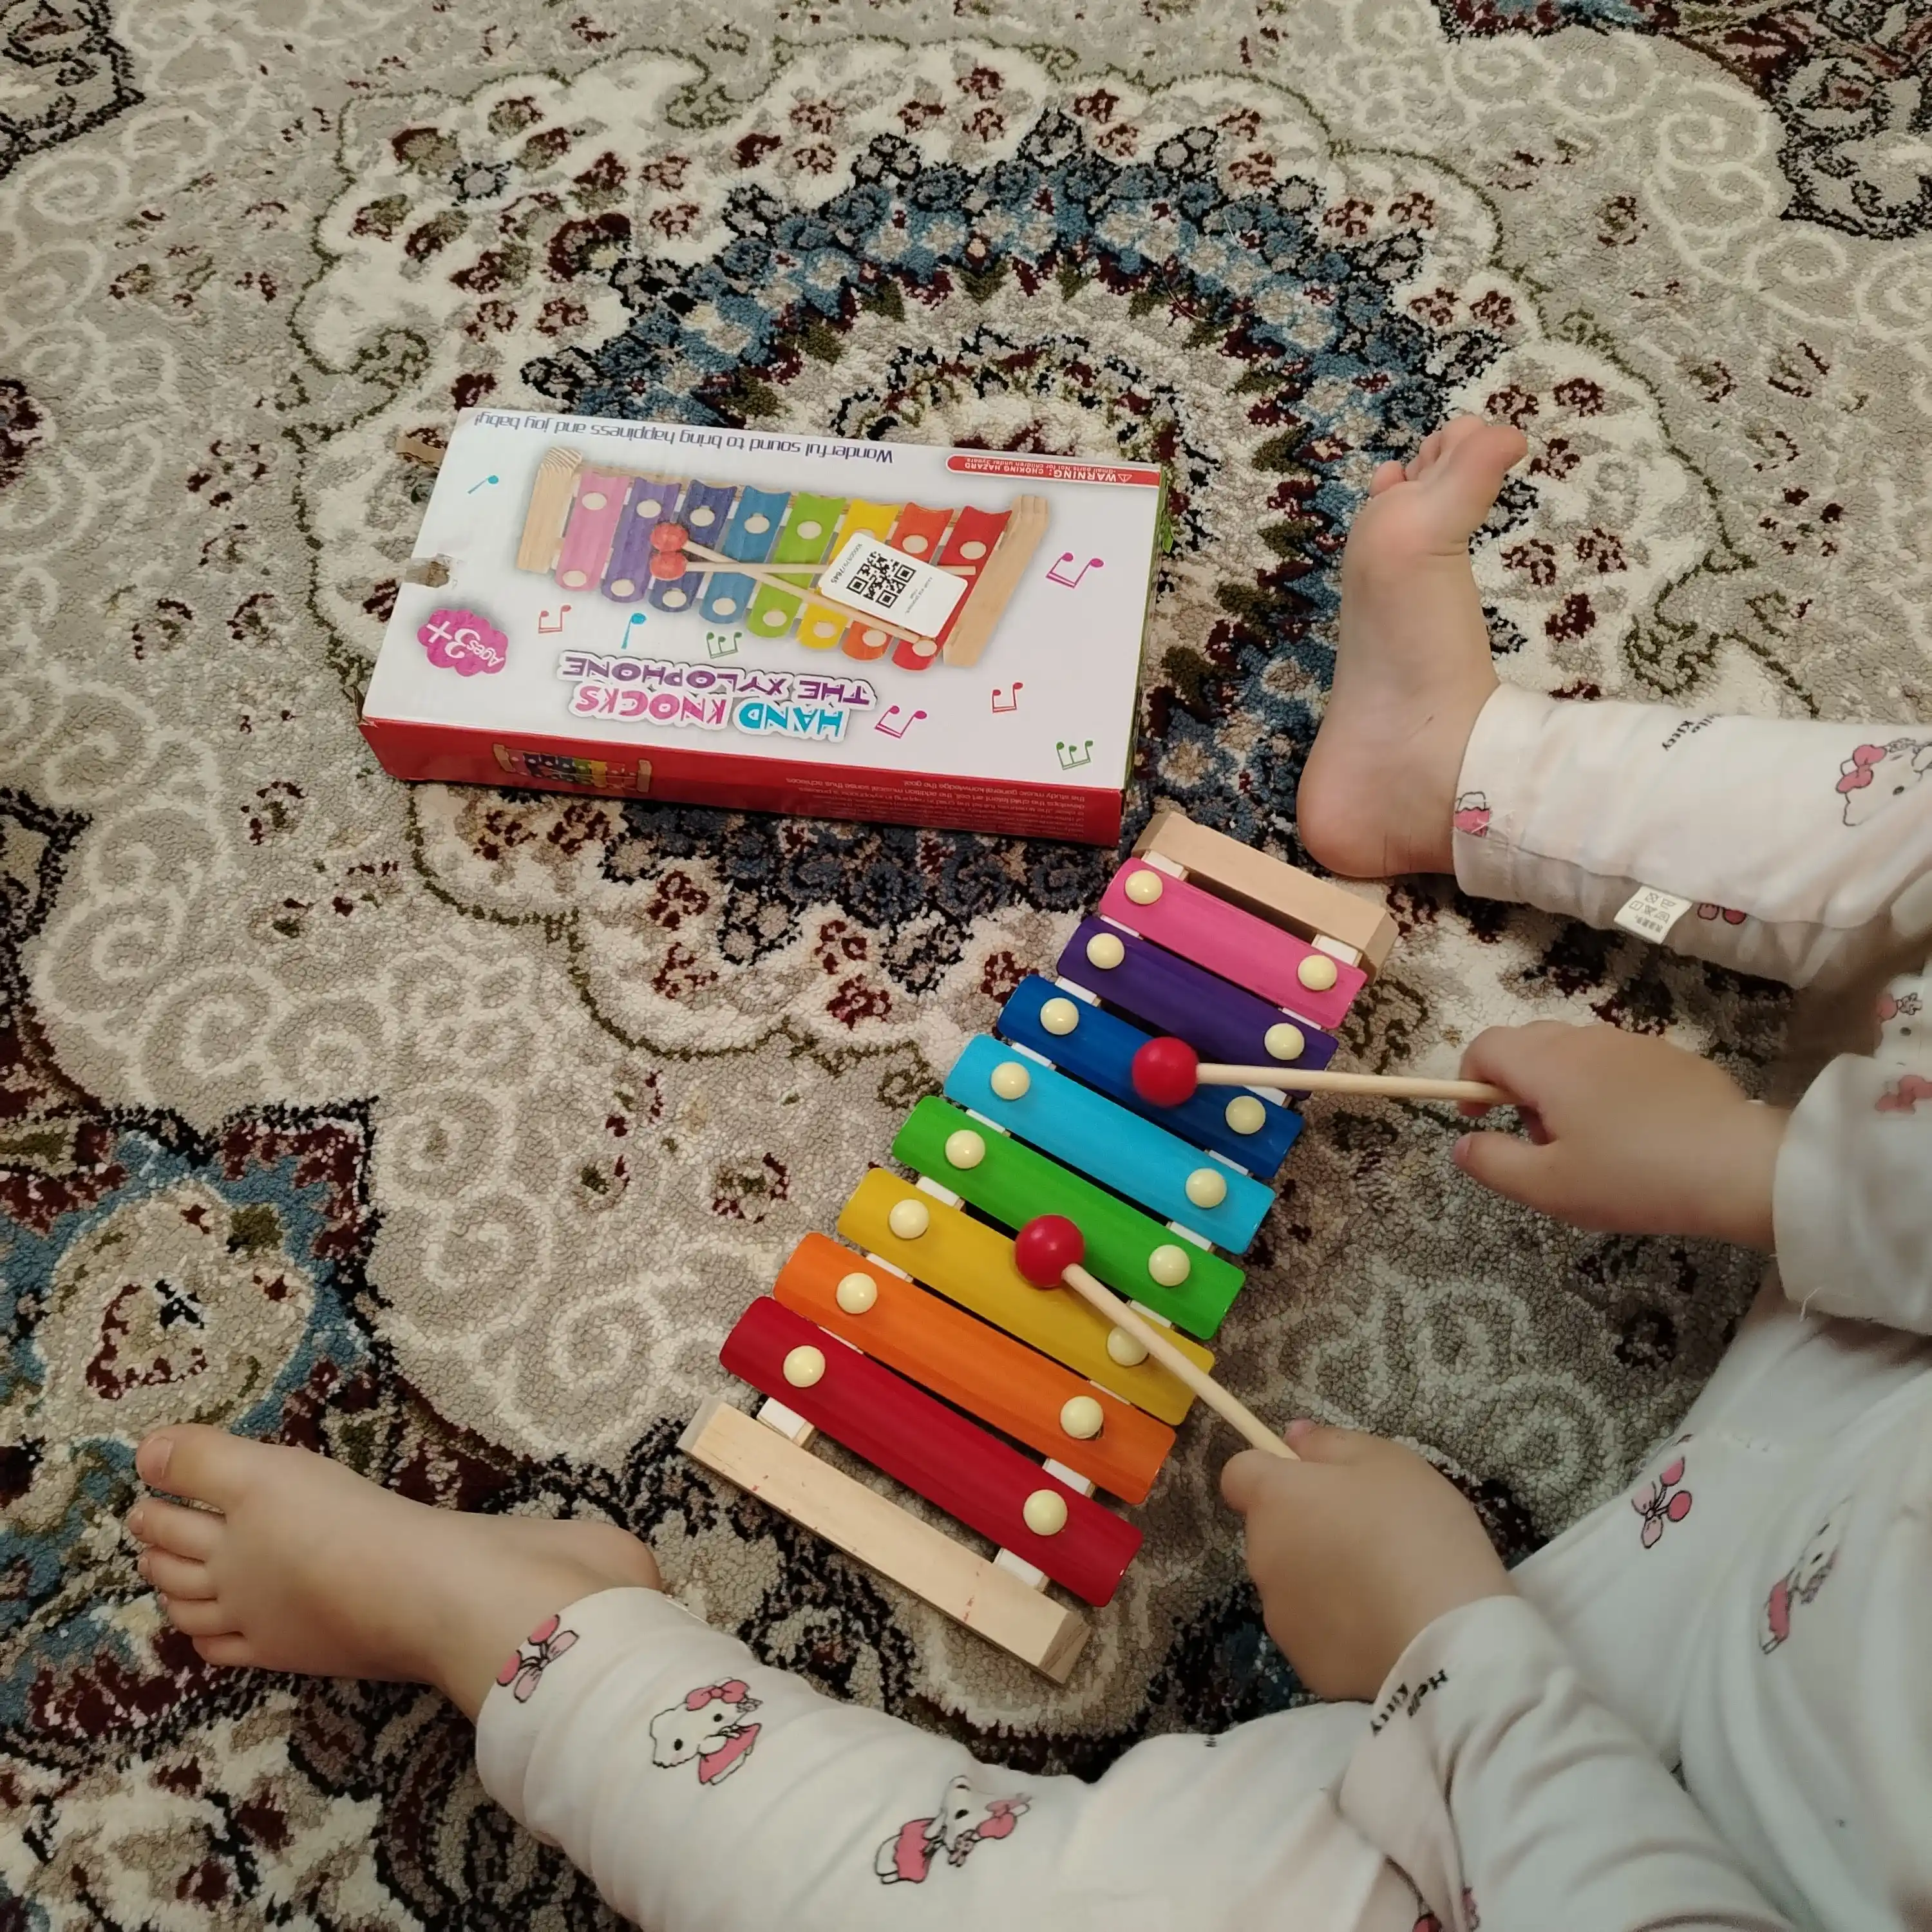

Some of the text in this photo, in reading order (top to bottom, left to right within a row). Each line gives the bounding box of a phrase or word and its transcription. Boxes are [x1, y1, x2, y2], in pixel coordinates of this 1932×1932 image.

[474, 412, 893, 464] Wonderful sound to bring happiness and joy baby!
[965, 462, 1117, 482] WARNING: CHOKING HAZARD
[1016, 460, 1044, 469] children
[426, 620, 505, 667] Ages 3+
[562, 656, 870, 705] THE XYLOPHONE
[575, 685, 844, 737] HAND KNOCKS
[1046, 793, 1069, 801] study
